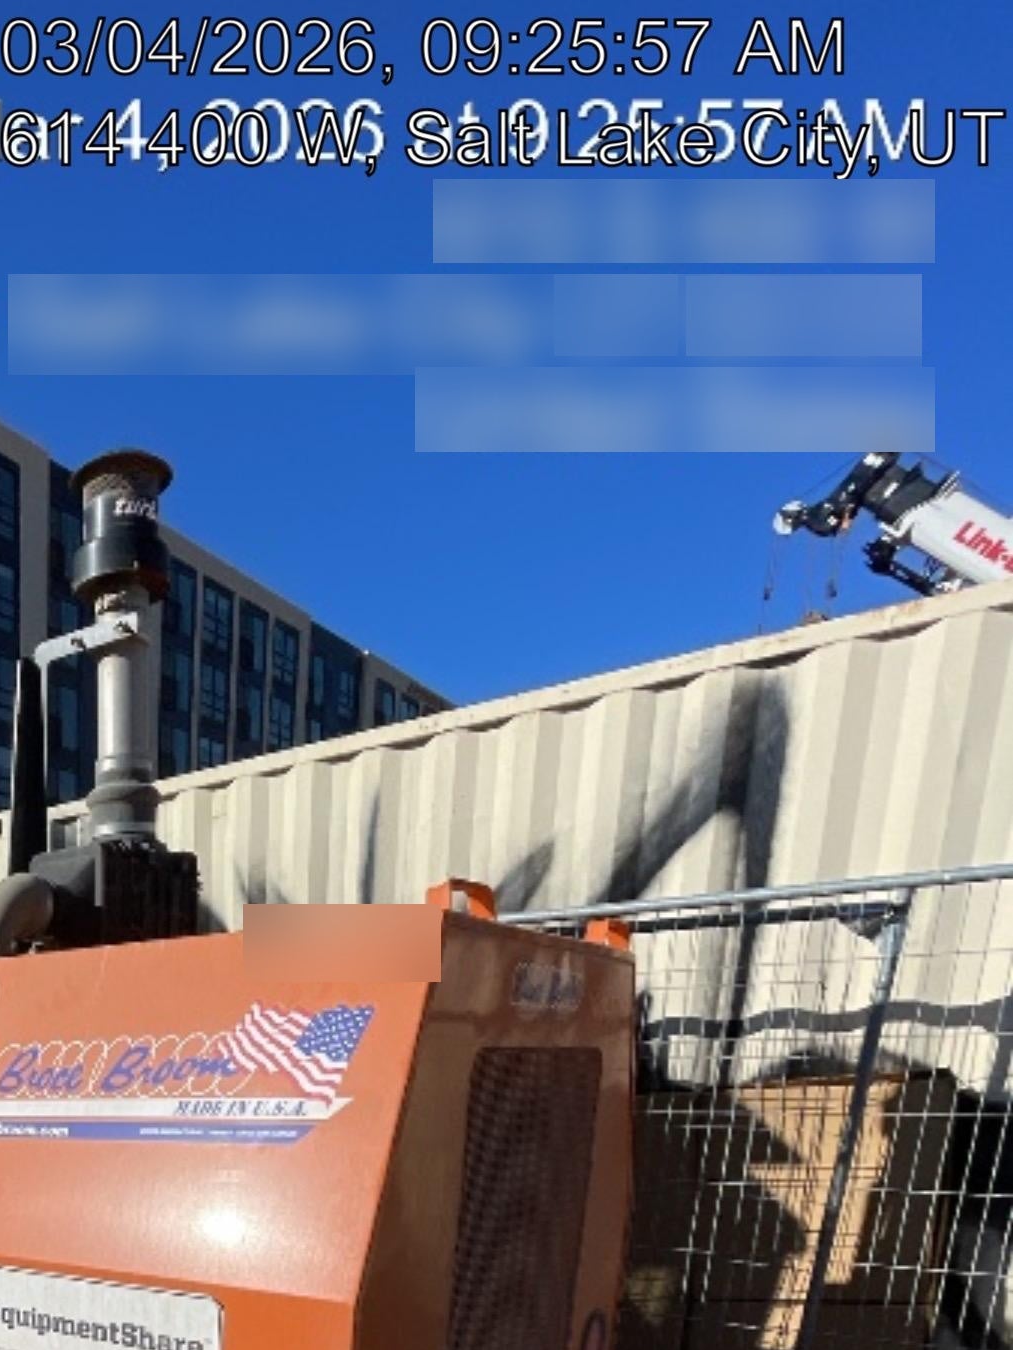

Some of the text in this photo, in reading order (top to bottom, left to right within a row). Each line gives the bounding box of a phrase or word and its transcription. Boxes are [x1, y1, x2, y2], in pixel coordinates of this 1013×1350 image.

[101, 1045, 237, 1092] Broom
[174, 1100, 222, 1117] MADE
[226, 1100, 250, 1117] IN
